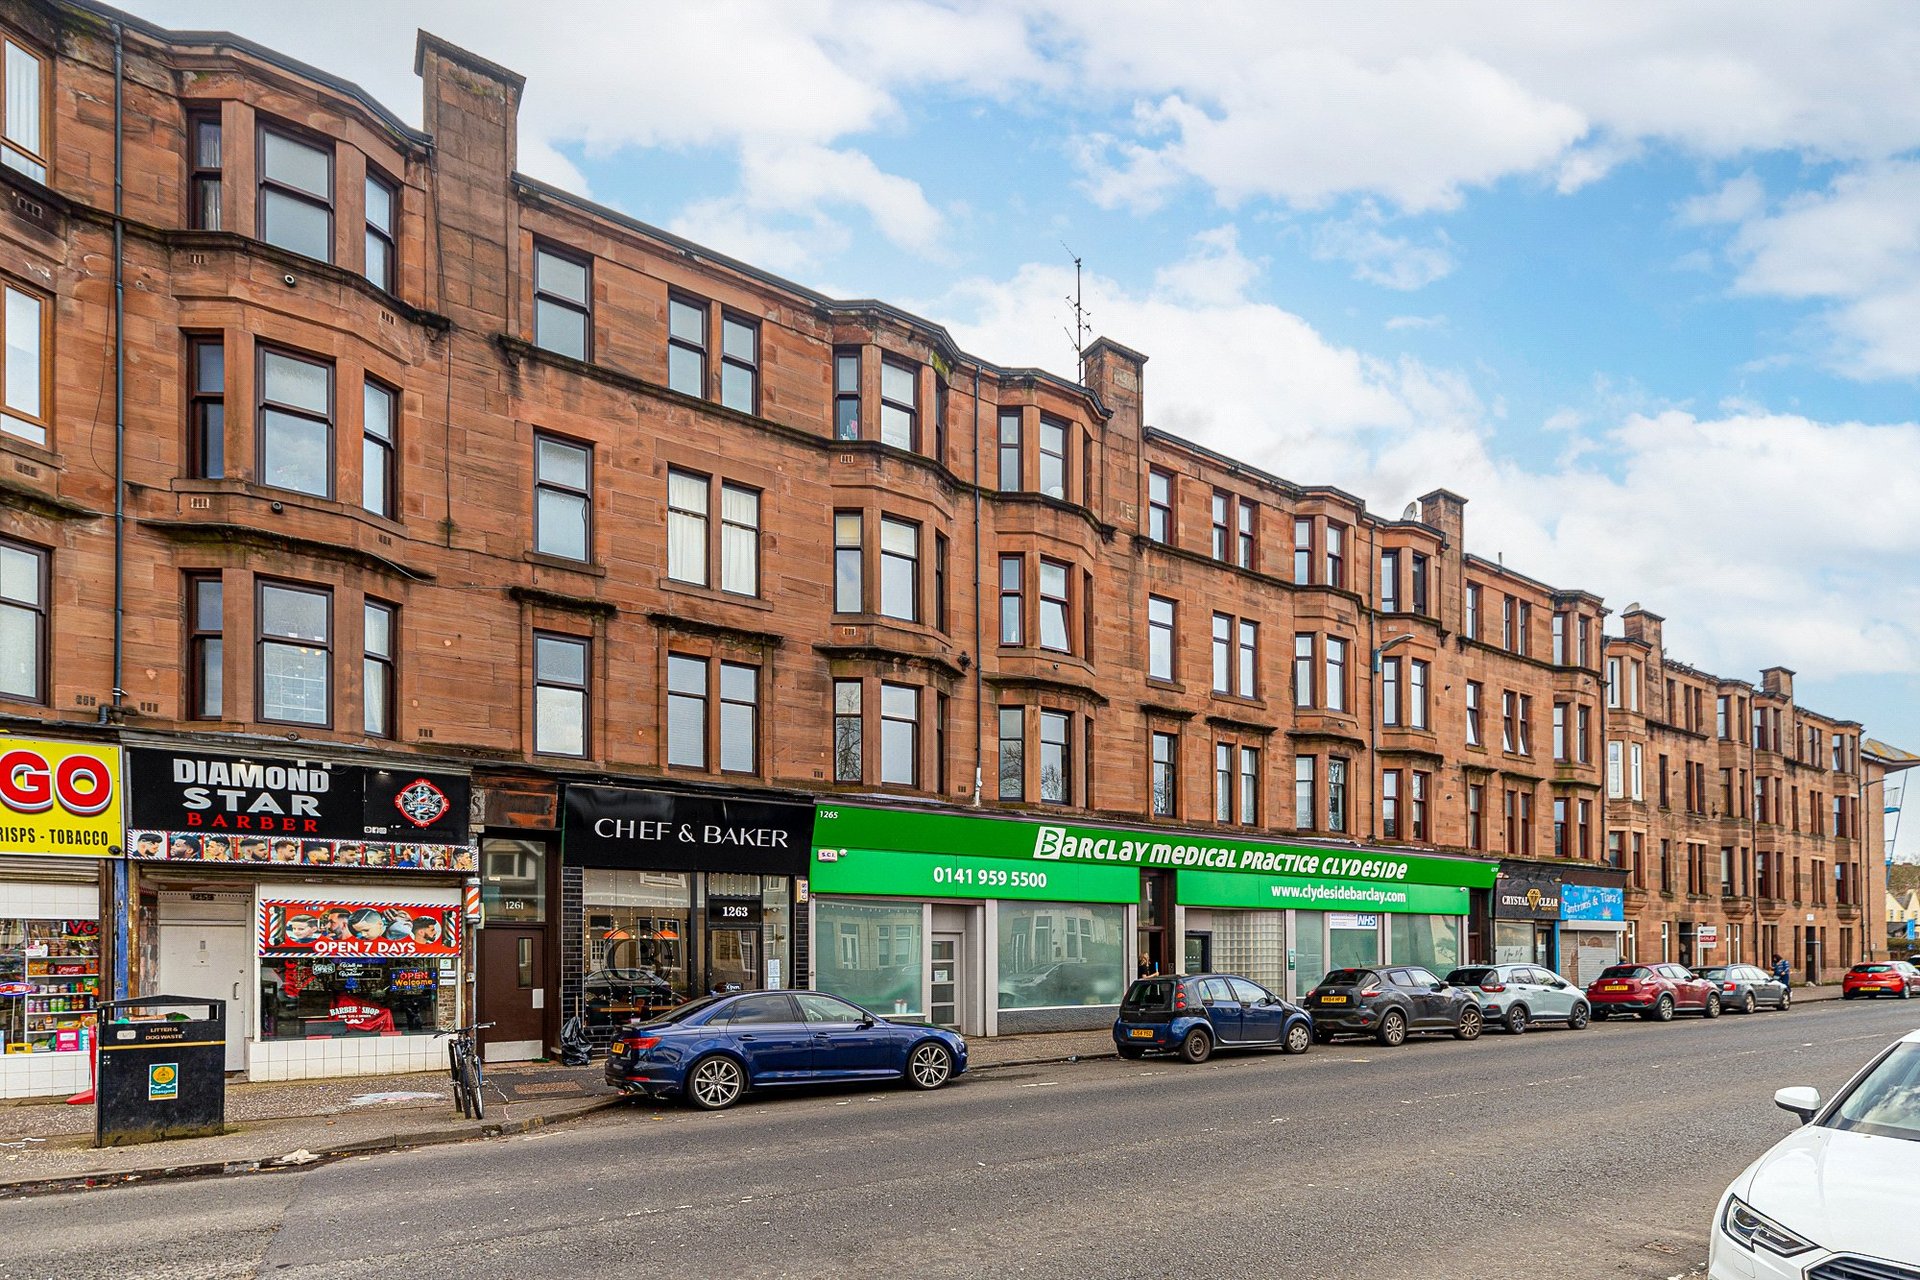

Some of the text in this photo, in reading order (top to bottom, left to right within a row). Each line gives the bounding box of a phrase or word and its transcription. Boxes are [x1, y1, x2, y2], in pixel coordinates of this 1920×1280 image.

[173, 758, 329, 793] DIAMOND
[0, 749, 113, 817] GO
[182, 787, 322, 817] STAR
[819, 810, 839, 819] 1265
[187, 812, 318, 832] BARBER
[49, 828, 108, 847] TOBACCO
[594, 818, 788, 848] CHEF & BAKER
[933, 866, 1048, 888] 0141 959 5500
[1271, 883, 1407, 905] www.clydesidebarclay.com
[505, 901, 524, 910] 1261
[1501, 895, 1558, 907] CRYSTAL CLEAR
[722, 906, 748, 917] 1263
[1358, 913, 1375, 926] NHS
[314, 941, 416, 953] OPEN 7 DAYS
[400, 971, 429, 980] OPEN
[395, 979, 433, 987] Welcome
[330, 1006, 380, 1017] BARBER SHOP
